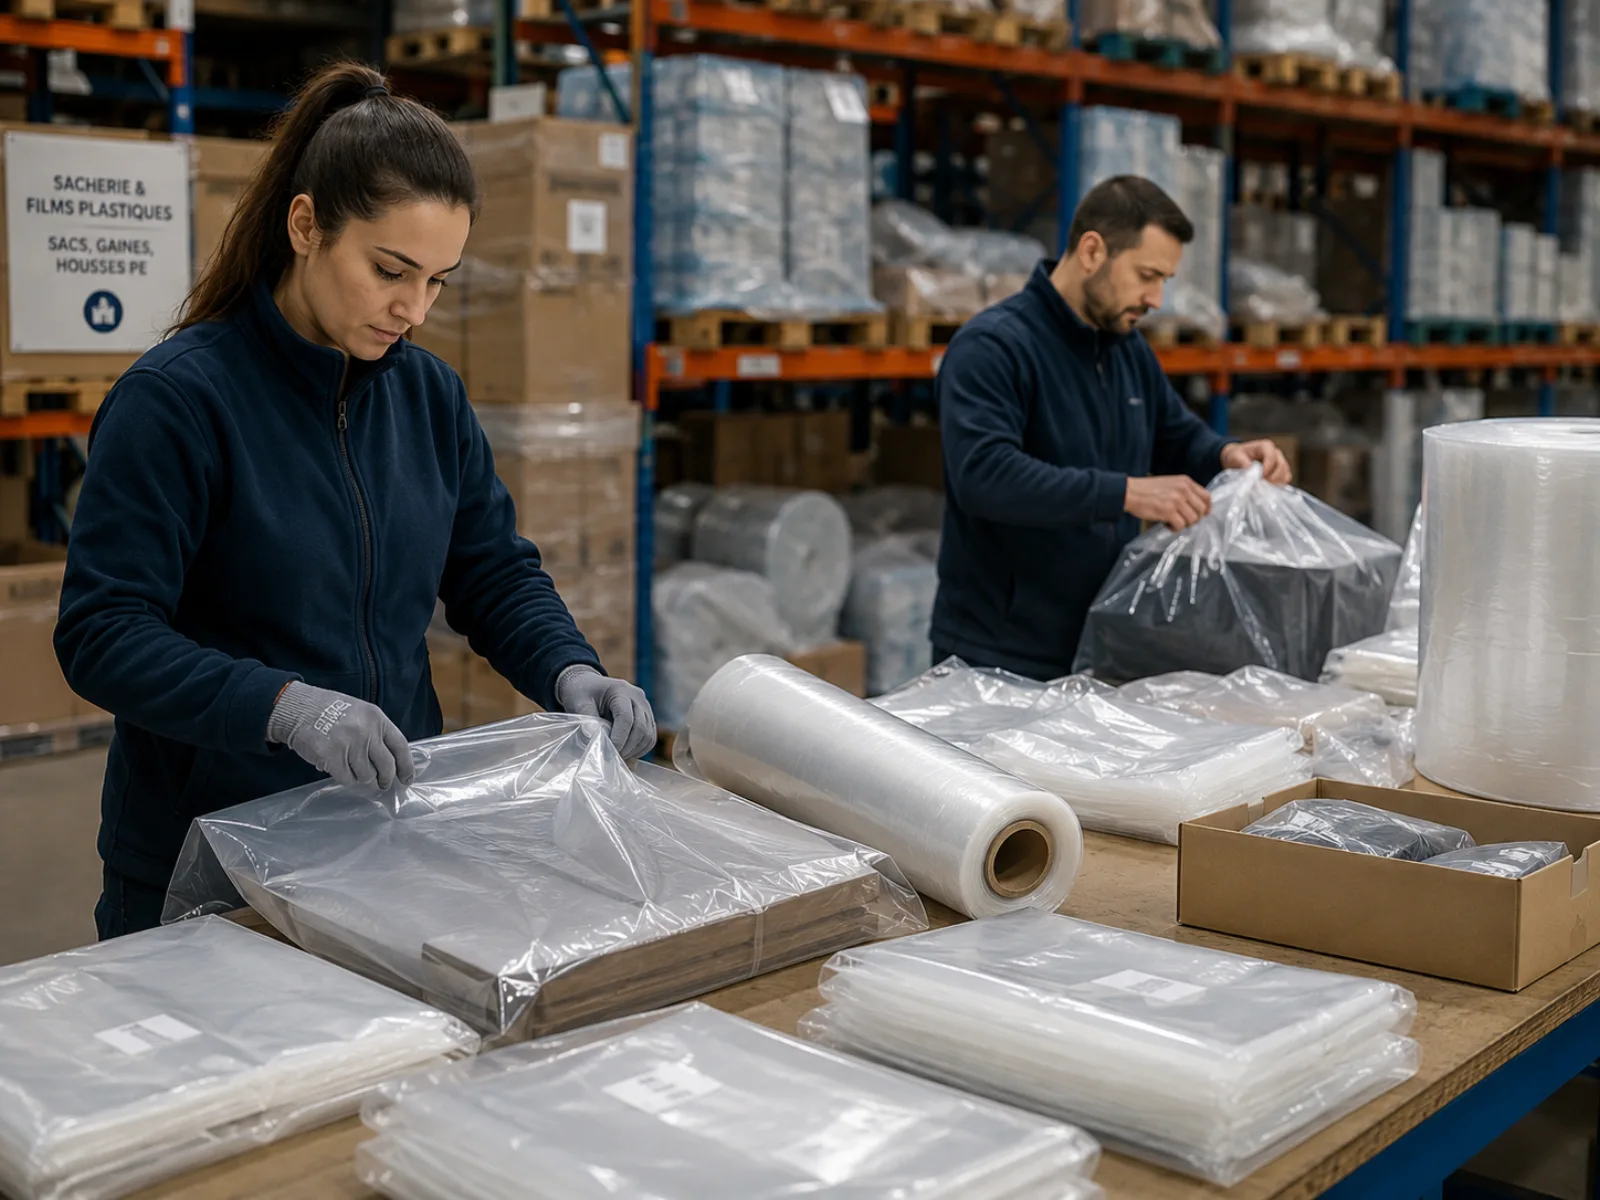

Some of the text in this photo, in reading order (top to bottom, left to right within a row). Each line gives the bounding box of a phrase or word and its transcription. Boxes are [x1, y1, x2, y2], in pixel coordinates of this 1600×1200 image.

[53, 174, 146, 196] SACHERIE &
[26, 197, 173, 221] FILMS PLASTIQUES
[48, 236, 154, 257] SACS, GAINES,
[56, 258, 148, 276] HOUSSES PE
